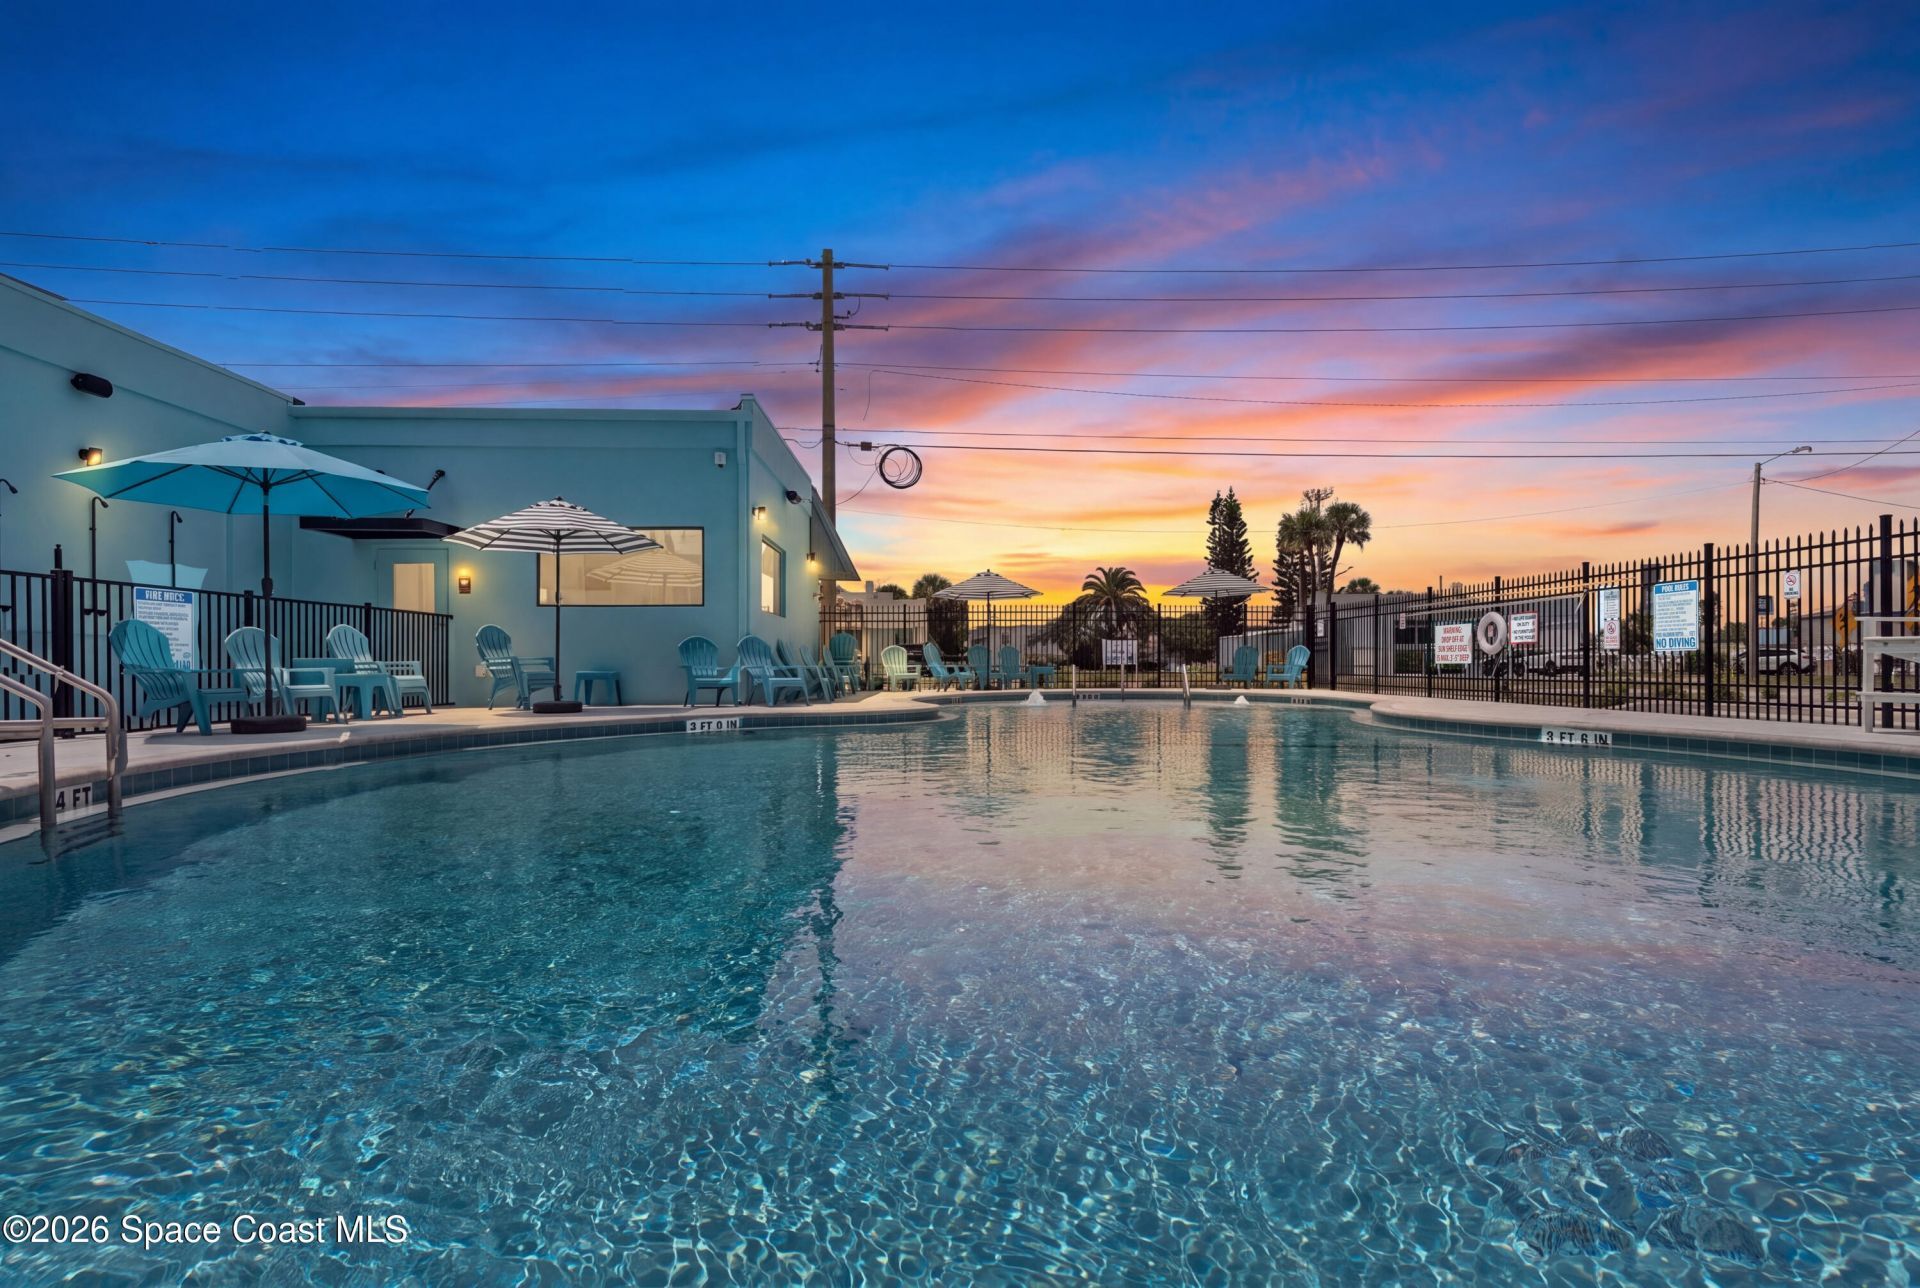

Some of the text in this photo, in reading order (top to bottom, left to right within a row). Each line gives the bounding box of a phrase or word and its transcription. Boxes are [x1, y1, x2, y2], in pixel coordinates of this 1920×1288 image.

[1661, 582, 1690, 593] POOL RULES
[1451, 635, 1459, 643] OFF
[1656, 636, 1696, 649] NO DIVING
[1445, 645, 1457, 653] SHELF
[1457, 644, 1468, 652] EDGE
[1459, 653, 1469, 661] DEEP
[690, 721, 696, 731] 3
[700, 721, 712, 731] FT
[726, 719, 737, 729] IN
[1546, 730, 1608, 745] 3 FT 6 IN
[55, 786, 91, 810] 4 FT
